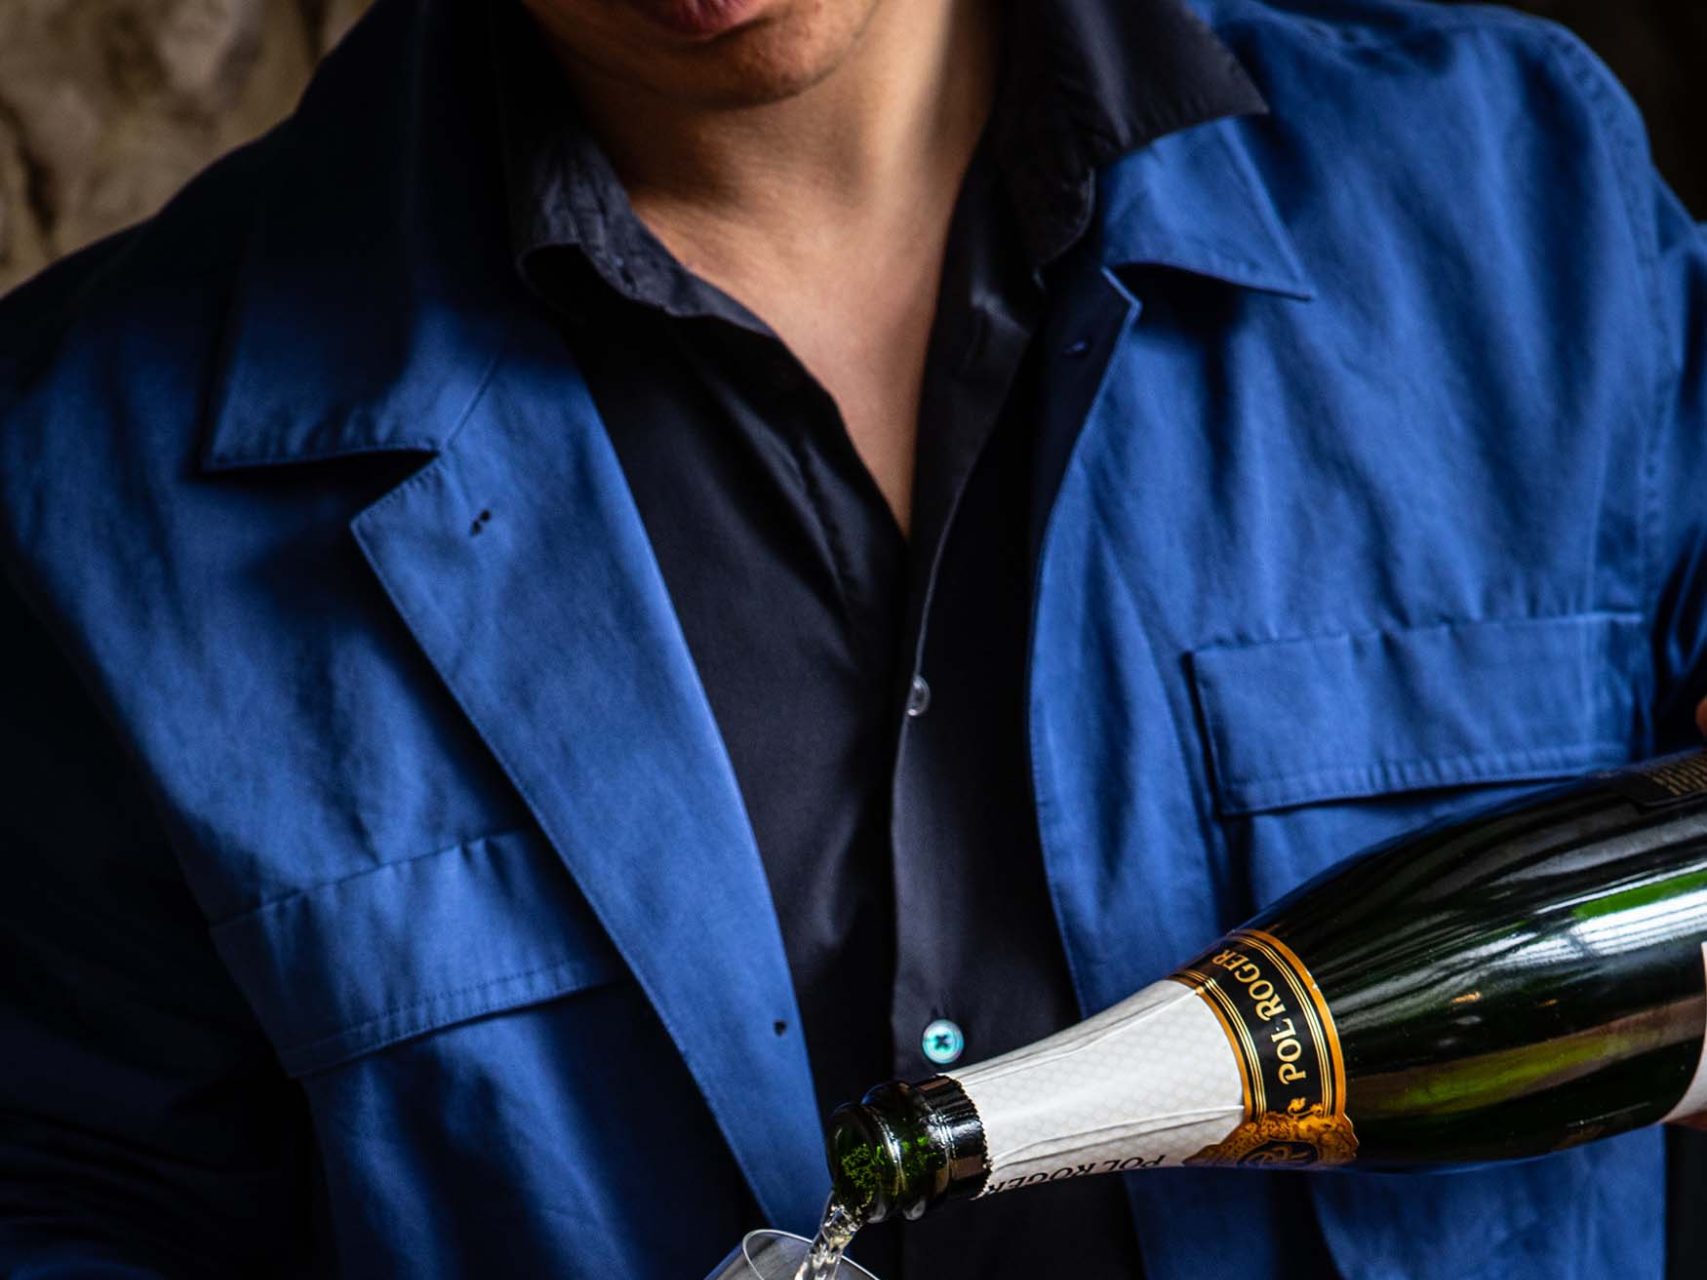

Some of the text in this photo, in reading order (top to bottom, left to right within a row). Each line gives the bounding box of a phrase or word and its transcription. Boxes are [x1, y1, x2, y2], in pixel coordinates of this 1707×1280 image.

[1212, 948, 1287, 1022] ROGER
[1270, 1017, 1307, 1085] POL
[1103, 1154, 1167, 1172] POL
